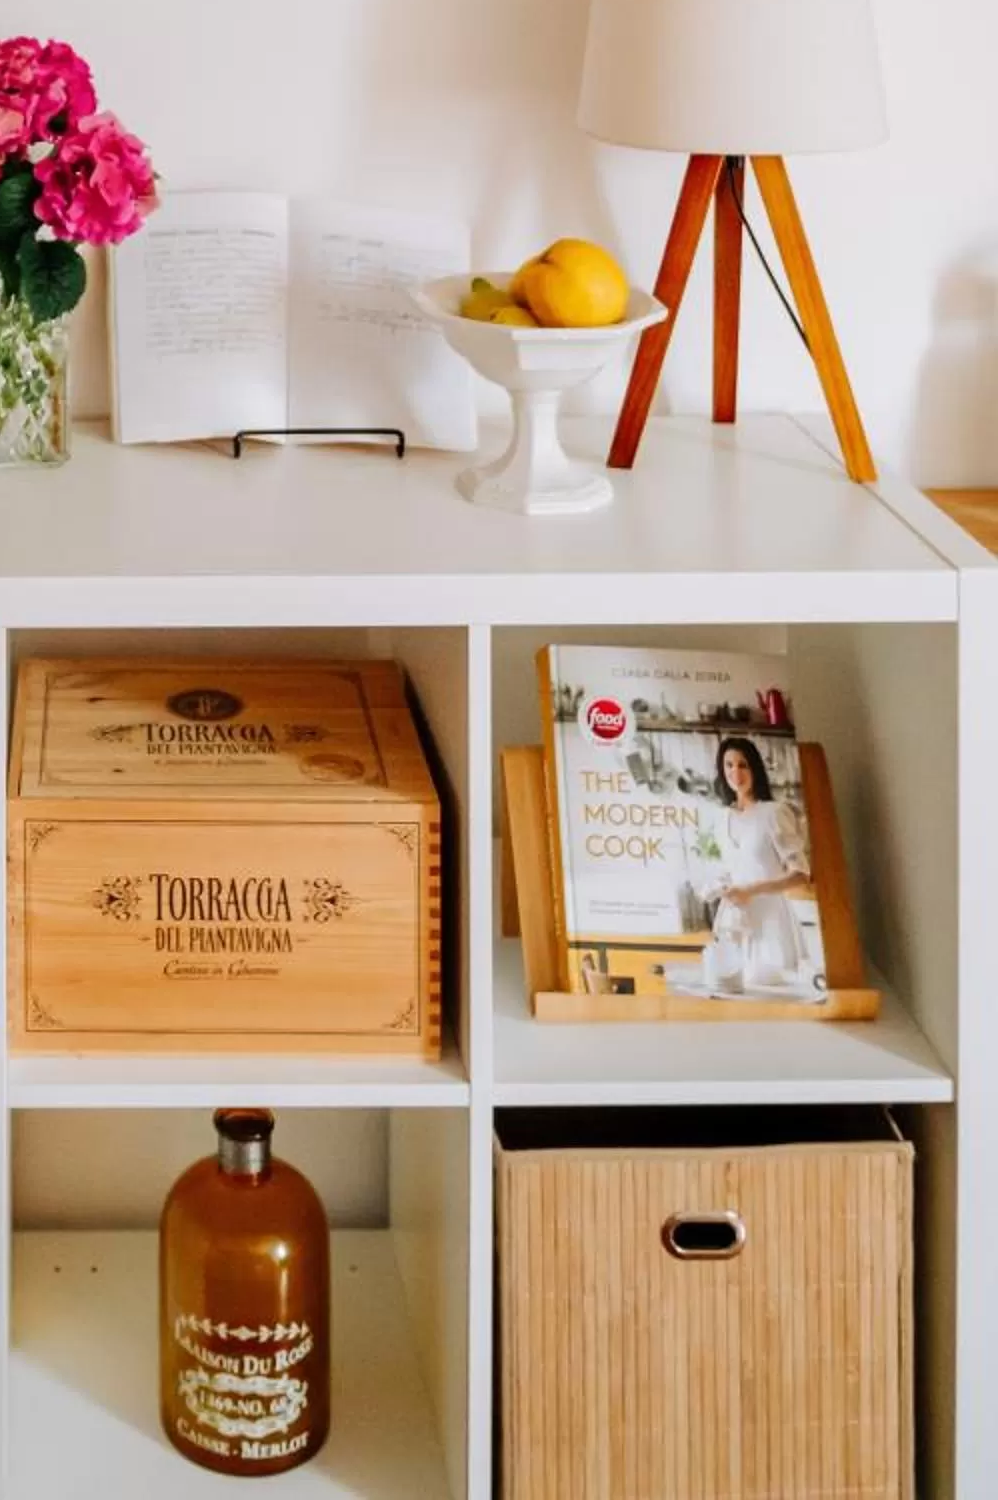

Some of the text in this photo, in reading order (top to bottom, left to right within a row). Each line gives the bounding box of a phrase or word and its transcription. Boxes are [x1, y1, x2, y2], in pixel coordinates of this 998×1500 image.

[579, 770, 632, 793] THE
[584, 803, 699, 828] MODERN
[155, 927, 293, 953] DEL PIANTAVIGNA
